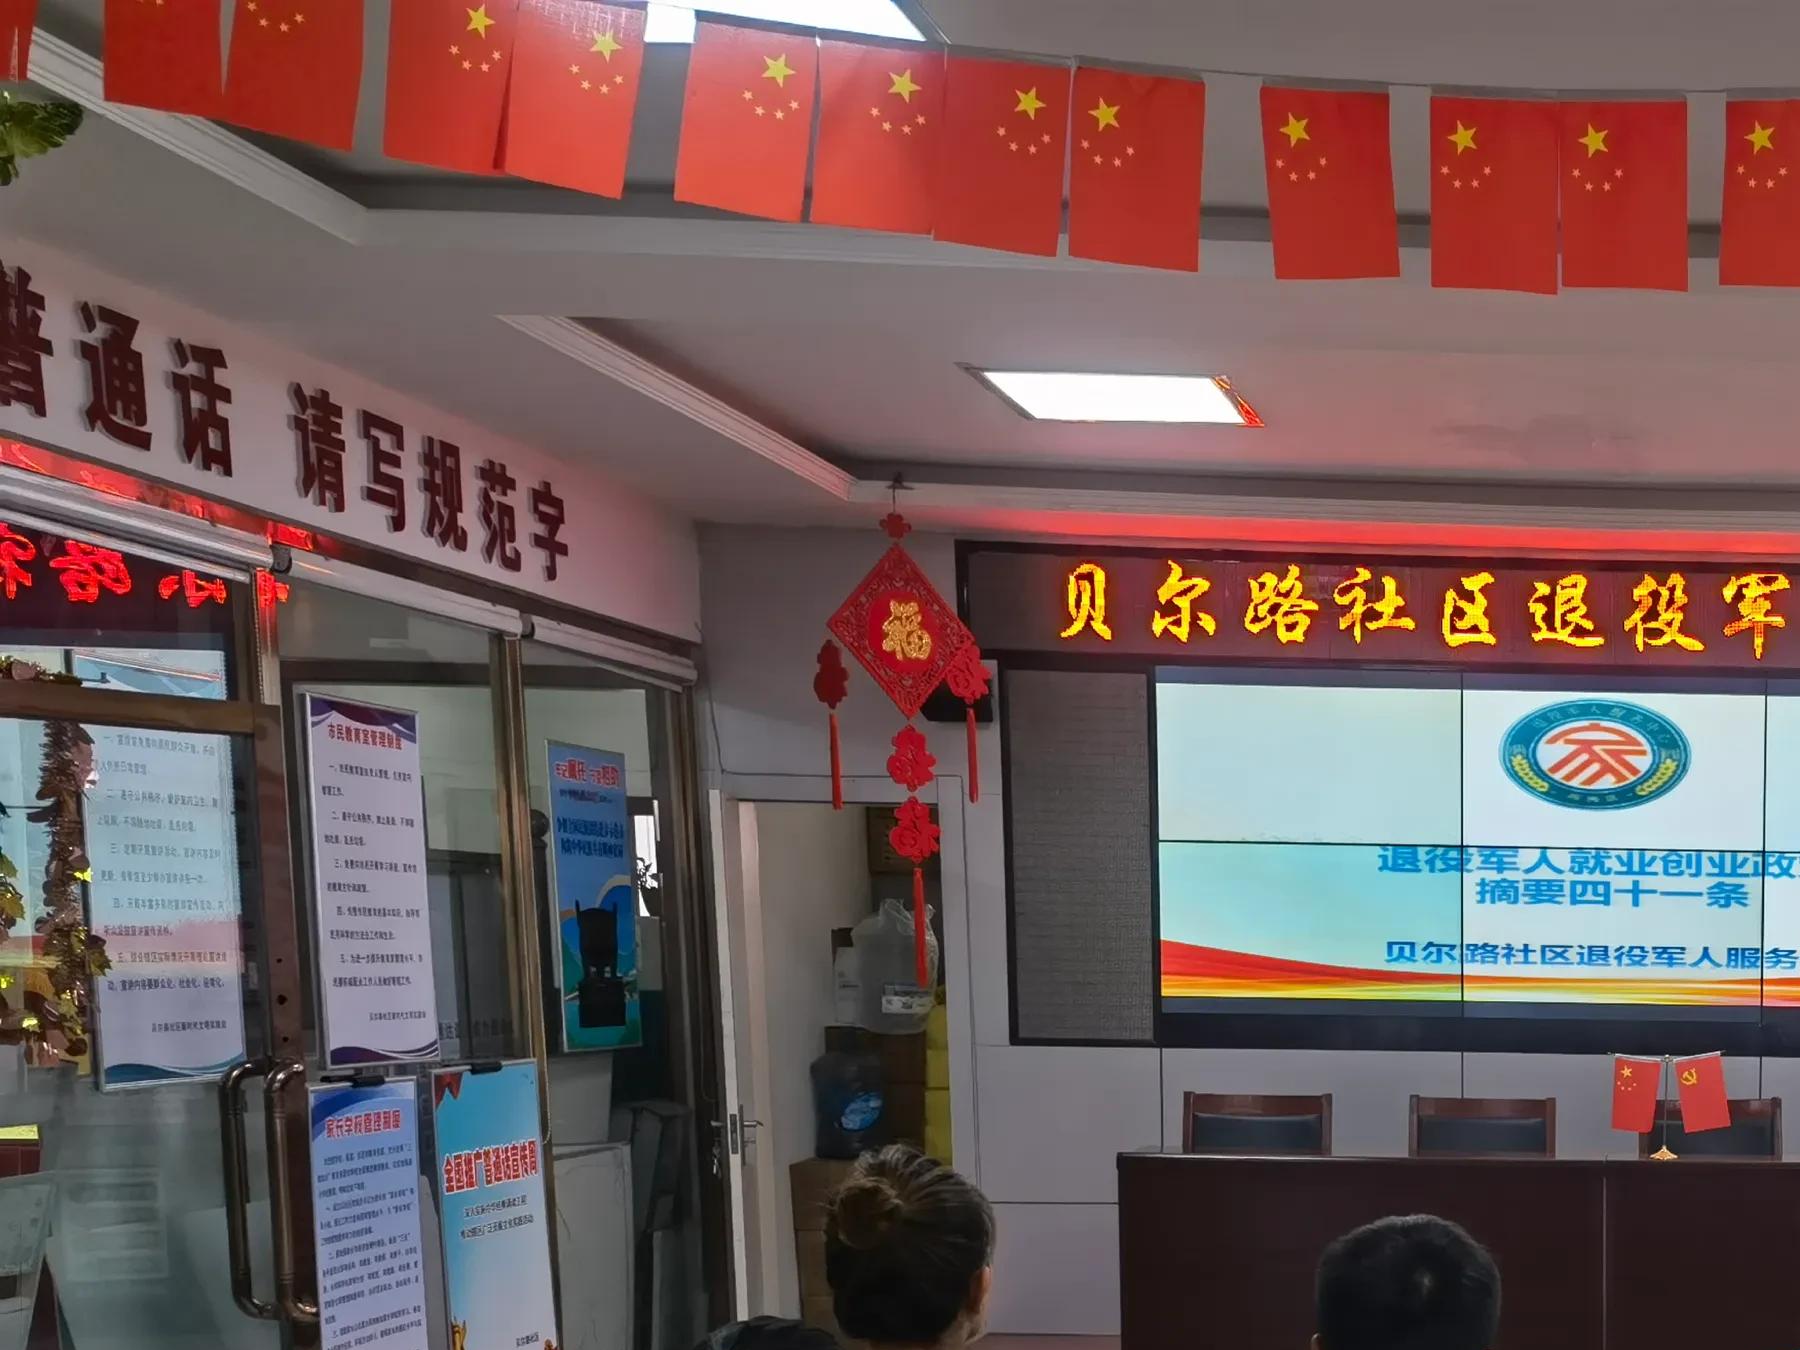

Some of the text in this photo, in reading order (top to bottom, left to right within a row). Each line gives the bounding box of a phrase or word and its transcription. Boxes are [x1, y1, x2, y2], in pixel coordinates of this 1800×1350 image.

[0, 258, 233, 478] 普通话
[288, 381, 569, 582] 请写规范字
[882, 599, 933, 661] 福
[1475, 876, 1751, 909] 摘要四十一条
